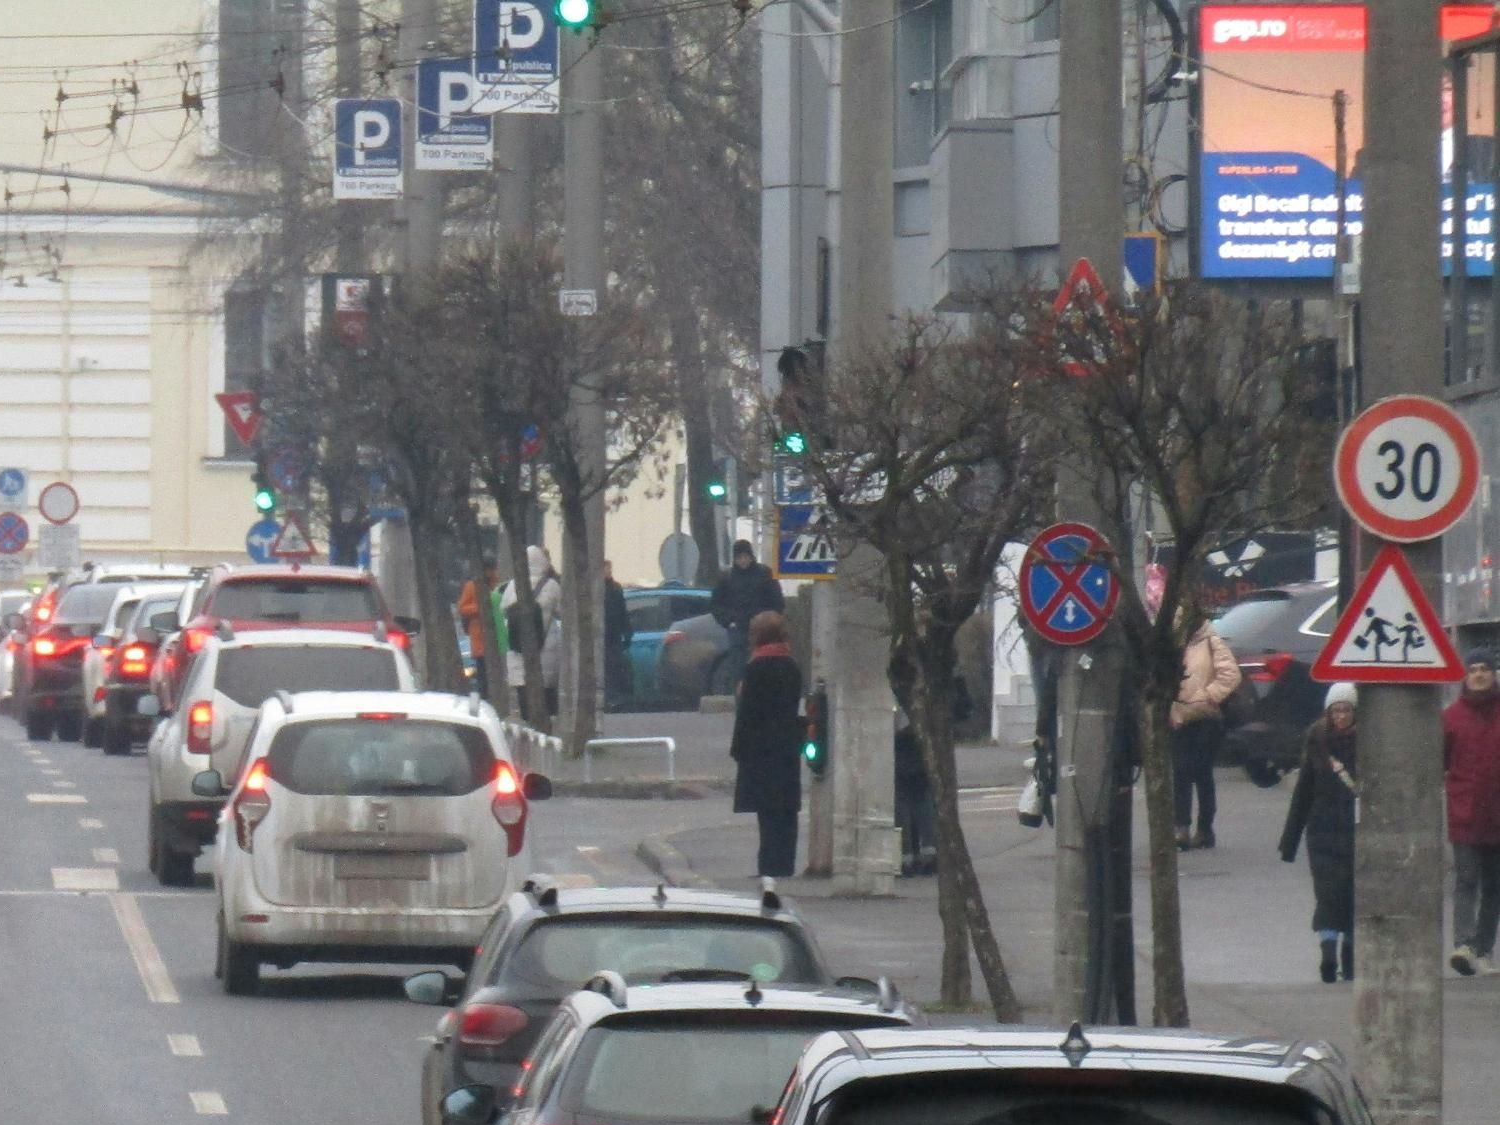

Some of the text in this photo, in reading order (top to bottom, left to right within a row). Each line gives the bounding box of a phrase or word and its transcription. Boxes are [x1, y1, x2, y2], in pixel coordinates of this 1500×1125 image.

[504, 90, 550, 103] Parking
[355, 111, 390, 165] P
[1375, 440, 1442, 502] 30
